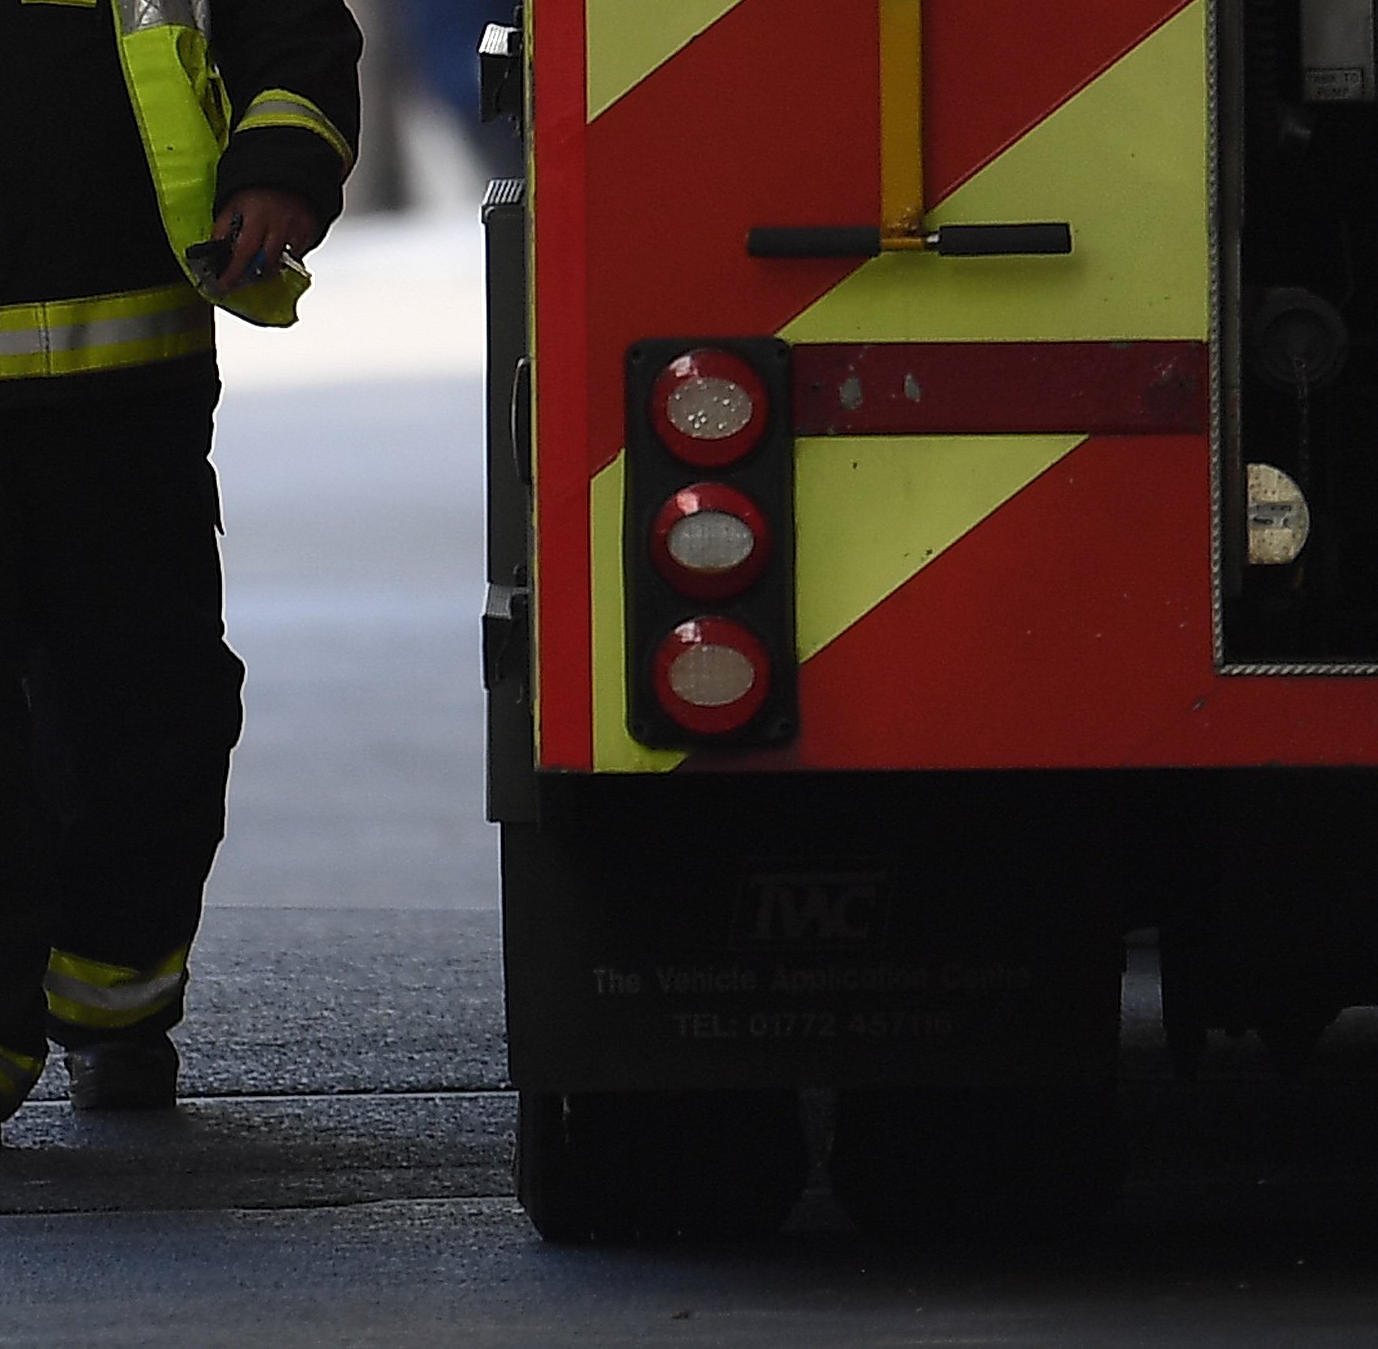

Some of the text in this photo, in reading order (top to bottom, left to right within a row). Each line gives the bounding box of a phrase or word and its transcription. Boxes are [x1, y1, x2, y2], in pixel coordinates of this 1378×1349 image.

[592, 965, 642, 995] The
[655, 964, 758, 993] Vehicle
[770, 963, 929, 997] Application
[674, 1013, 737, 1038] TEL:
[748, 1012, 836, 1038] 01772
